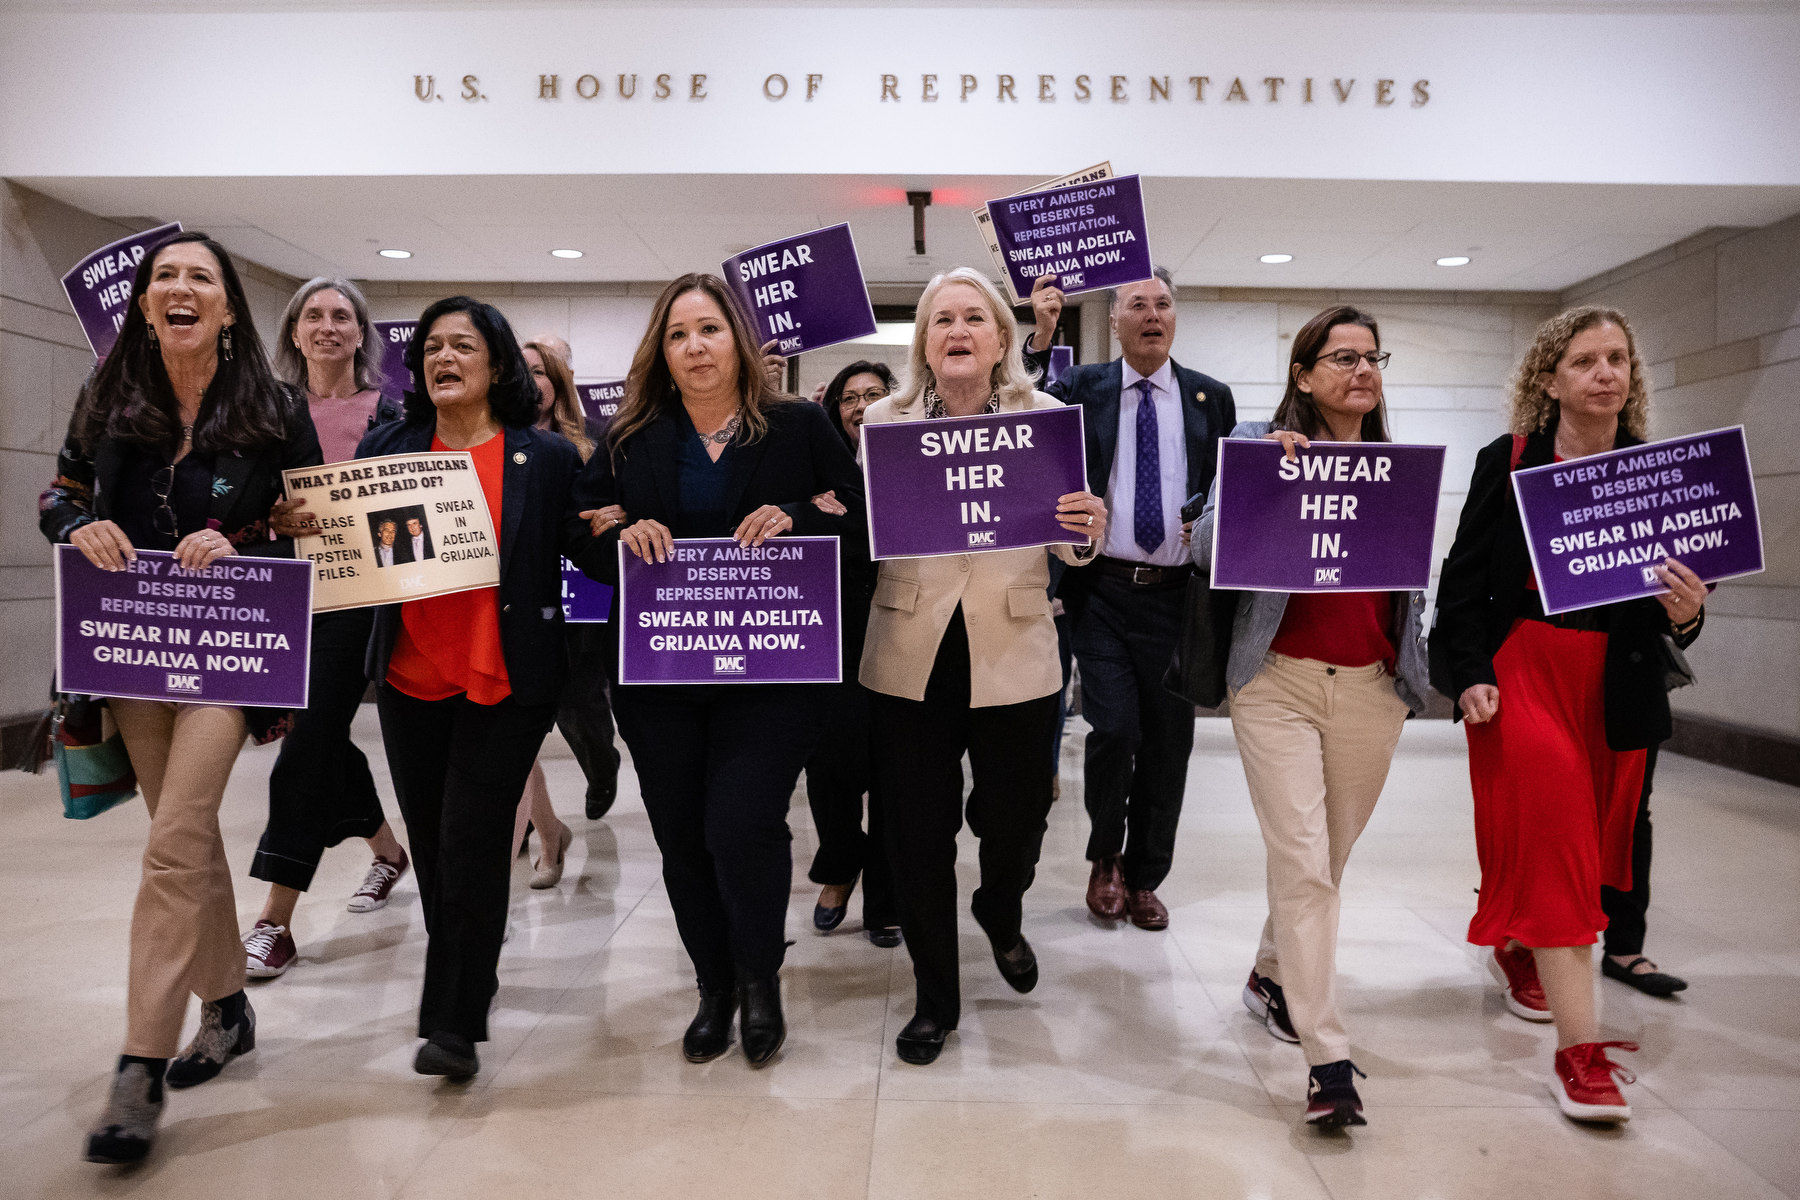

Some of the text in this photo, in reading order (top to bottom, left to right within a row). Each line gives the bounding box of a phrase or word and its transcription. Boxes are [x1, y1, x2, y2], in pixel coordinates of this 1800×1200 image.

[413, 74, 1432, 107] U.S. HOUSE OF REPRESENTATIVES
[1009, 185, 1115, 214] EVERY AMERICAN
[1032, 204, 1095, 224] DESERVES
[1014, 215, 1120, 242] REPRESENTATION.
[1009, 245, 1053, 262] SWEAR
[1057, 241, 1072, 255] IN
[1077, 230, 1135, 251] ADELITA
[82, 245, 146, 290] SWEAR
[739, 244, 814, 282] SWEAR
[1020, 258, 1081, 277] GRIJALVA
[1084, 250, 1125, 269] NOW.
[1062, 273, 1084, 287] DWC
[98, 280, 132, 311] HER
[754, 280, 798, 308] HER
[768, 311, 801, 335] IN.
[780, 337, 801, 350] DWC
[589, 385, 625, 400] SWEAR
[920, 424, 1034, 457] SWEAR
[290, 459, 468, 490] WHAT ARE REPUBLICANS
[946, 464, 1005, 490] HER
[1278, 454, 1392, 482] SWEAR
[1553, 442, 1711, 488] EVERY AMERICAN
[330, 475, 443, 502] SO AFRAID OF?
[1592, 468, 1683, 500] DESERVES
[435, 499, 475, 513] SWEAR
[960, 500, 1001, 524] IN.
[1300, 494, 1358, 520] HER
[1562, 482, 1720, 526] REPRESENTATION.
[455, 517, 467, 527] IN
[1550, 501, 1742, 555] SWEAR IN ADELITA
[320, 534, 345, 546] THE
[443, 531, 486, 546] ADELITA
[968, 531, 995, 545] DWC
[1311, 533, 1348, 558] IN.
[441, 547, 494, 563] GRIJALVA.
[666, 547, 803, 562] VERY AMERICAN
[1568, 543, 1669, 576] GRIJALVA
[1673, 529, 1729, 556] NOW.
[126, 560, 163, 576] ERY
[318, 566, 360, 581] FILES.
[687, 567, 772, 581] DESERVES
[1315, 568, 1340, 582] DWC
[138, 581, 236, 600] DESERVES
[656, 586, 804, 601] REPRESENTATION.
[101, 598, 270, 623] REPRESENTATION.
[638, 610, 823, 628] SWEAR IN ADELITA
[80, 620, 290, 650] SWEAR IN ADELITA
[650, 634, 806, 651] GRIJALVA NOW.
[94, 646, 269, 673] GRIJALVA NOW.
[715, 657, 743, 671] DWC
[168, 674, 200, 690] DWC
